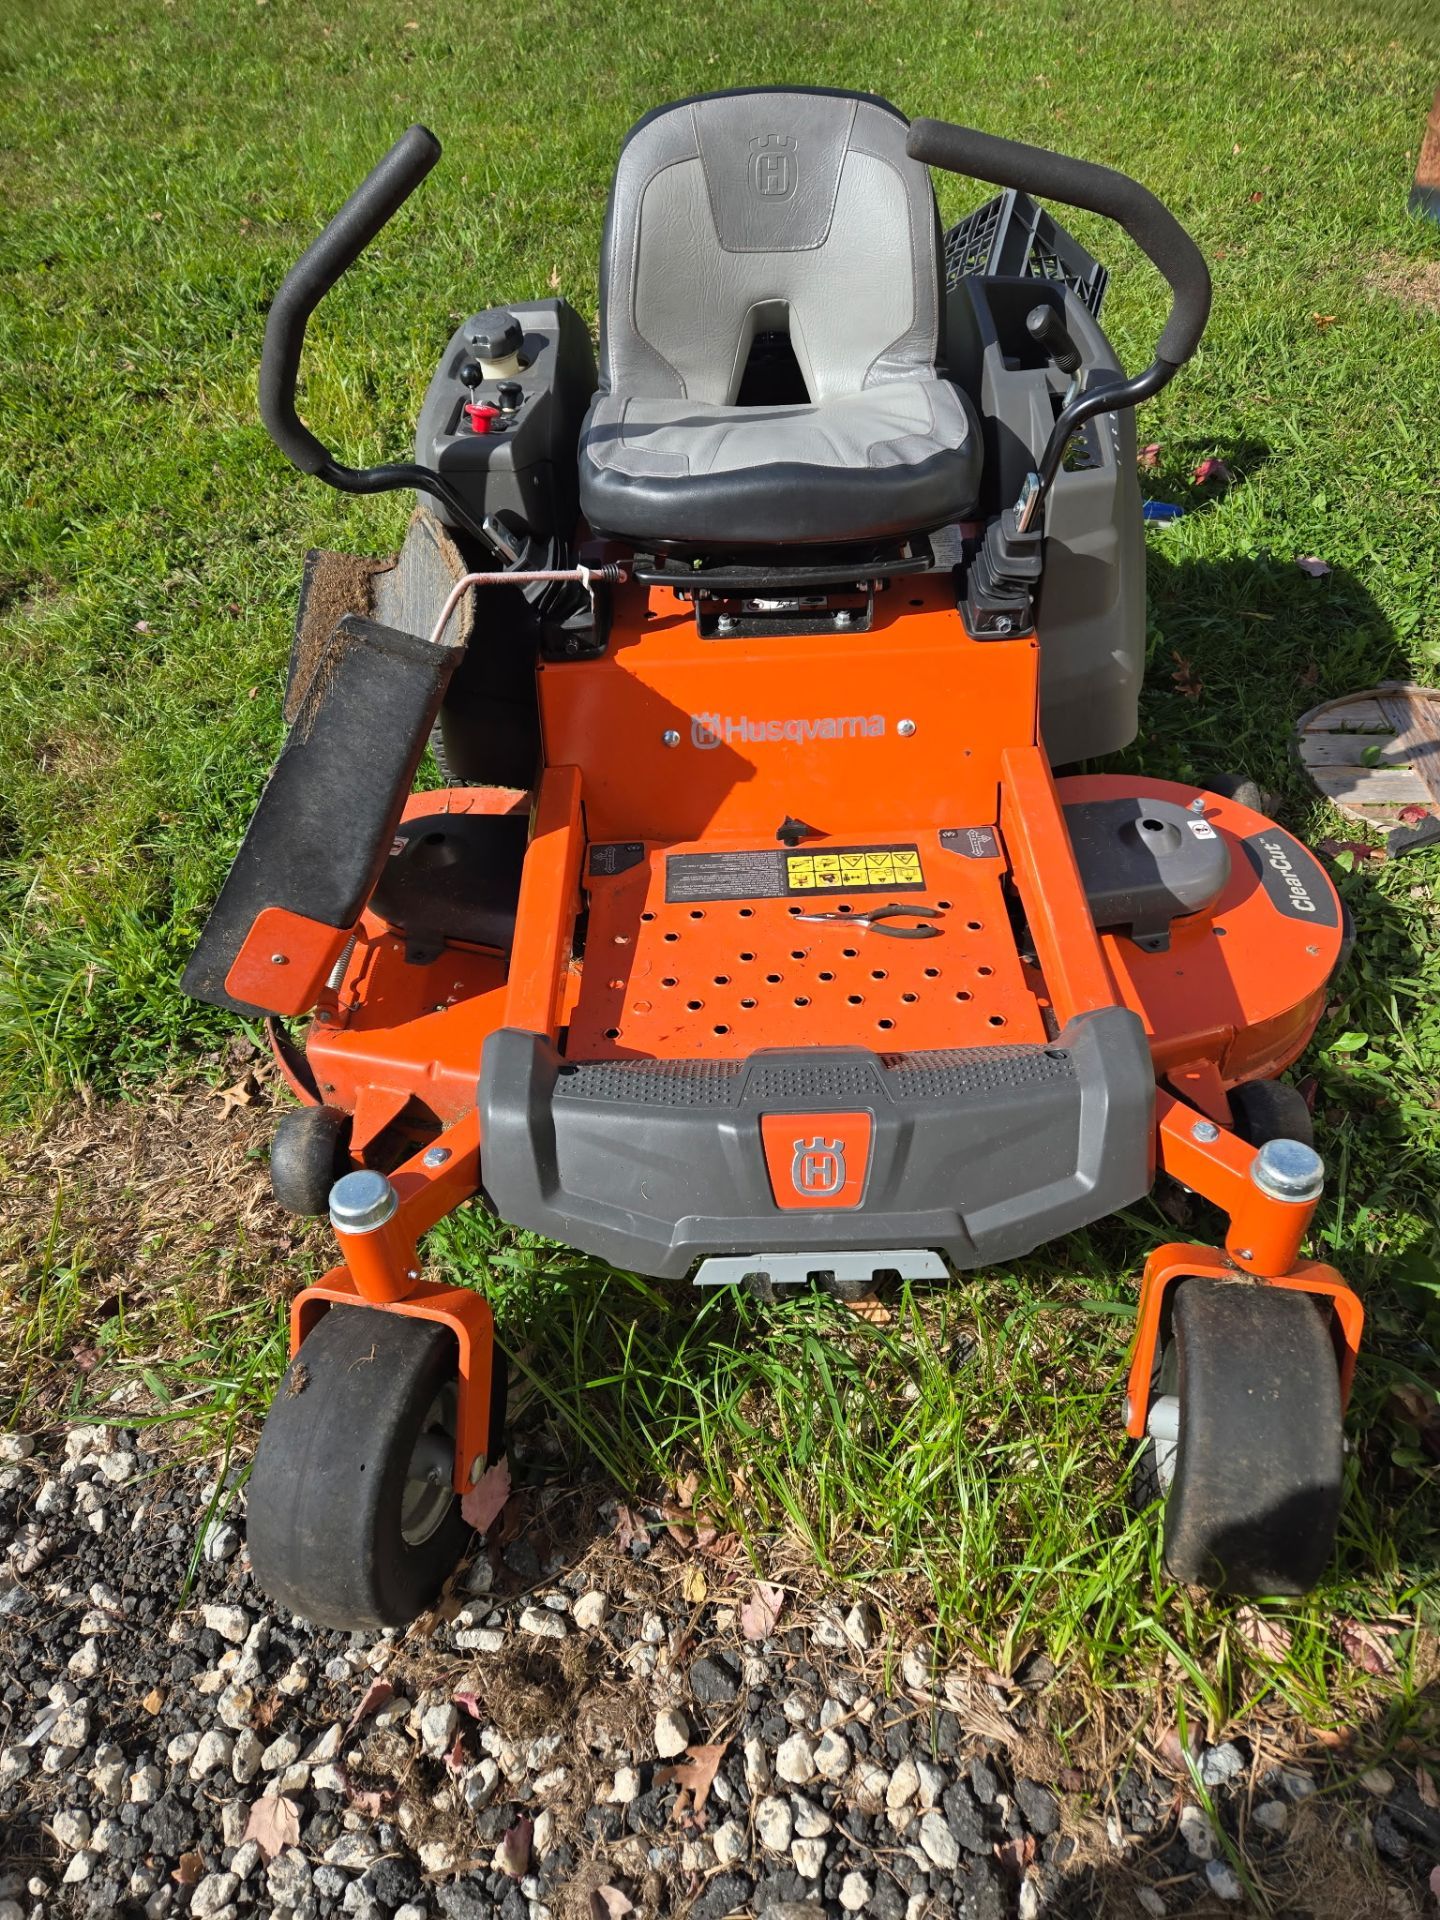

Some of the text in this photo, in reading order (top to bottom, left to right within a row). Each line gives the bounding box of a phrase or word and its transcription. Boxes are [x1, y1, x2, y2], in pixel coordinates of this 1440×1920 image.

[761, 157, 786, 192] H
[724, 714, 886, 744] Husqvarna
[1264, 843, 1316, 912] ClearCut
[805, 1156, 832, 1185] H
